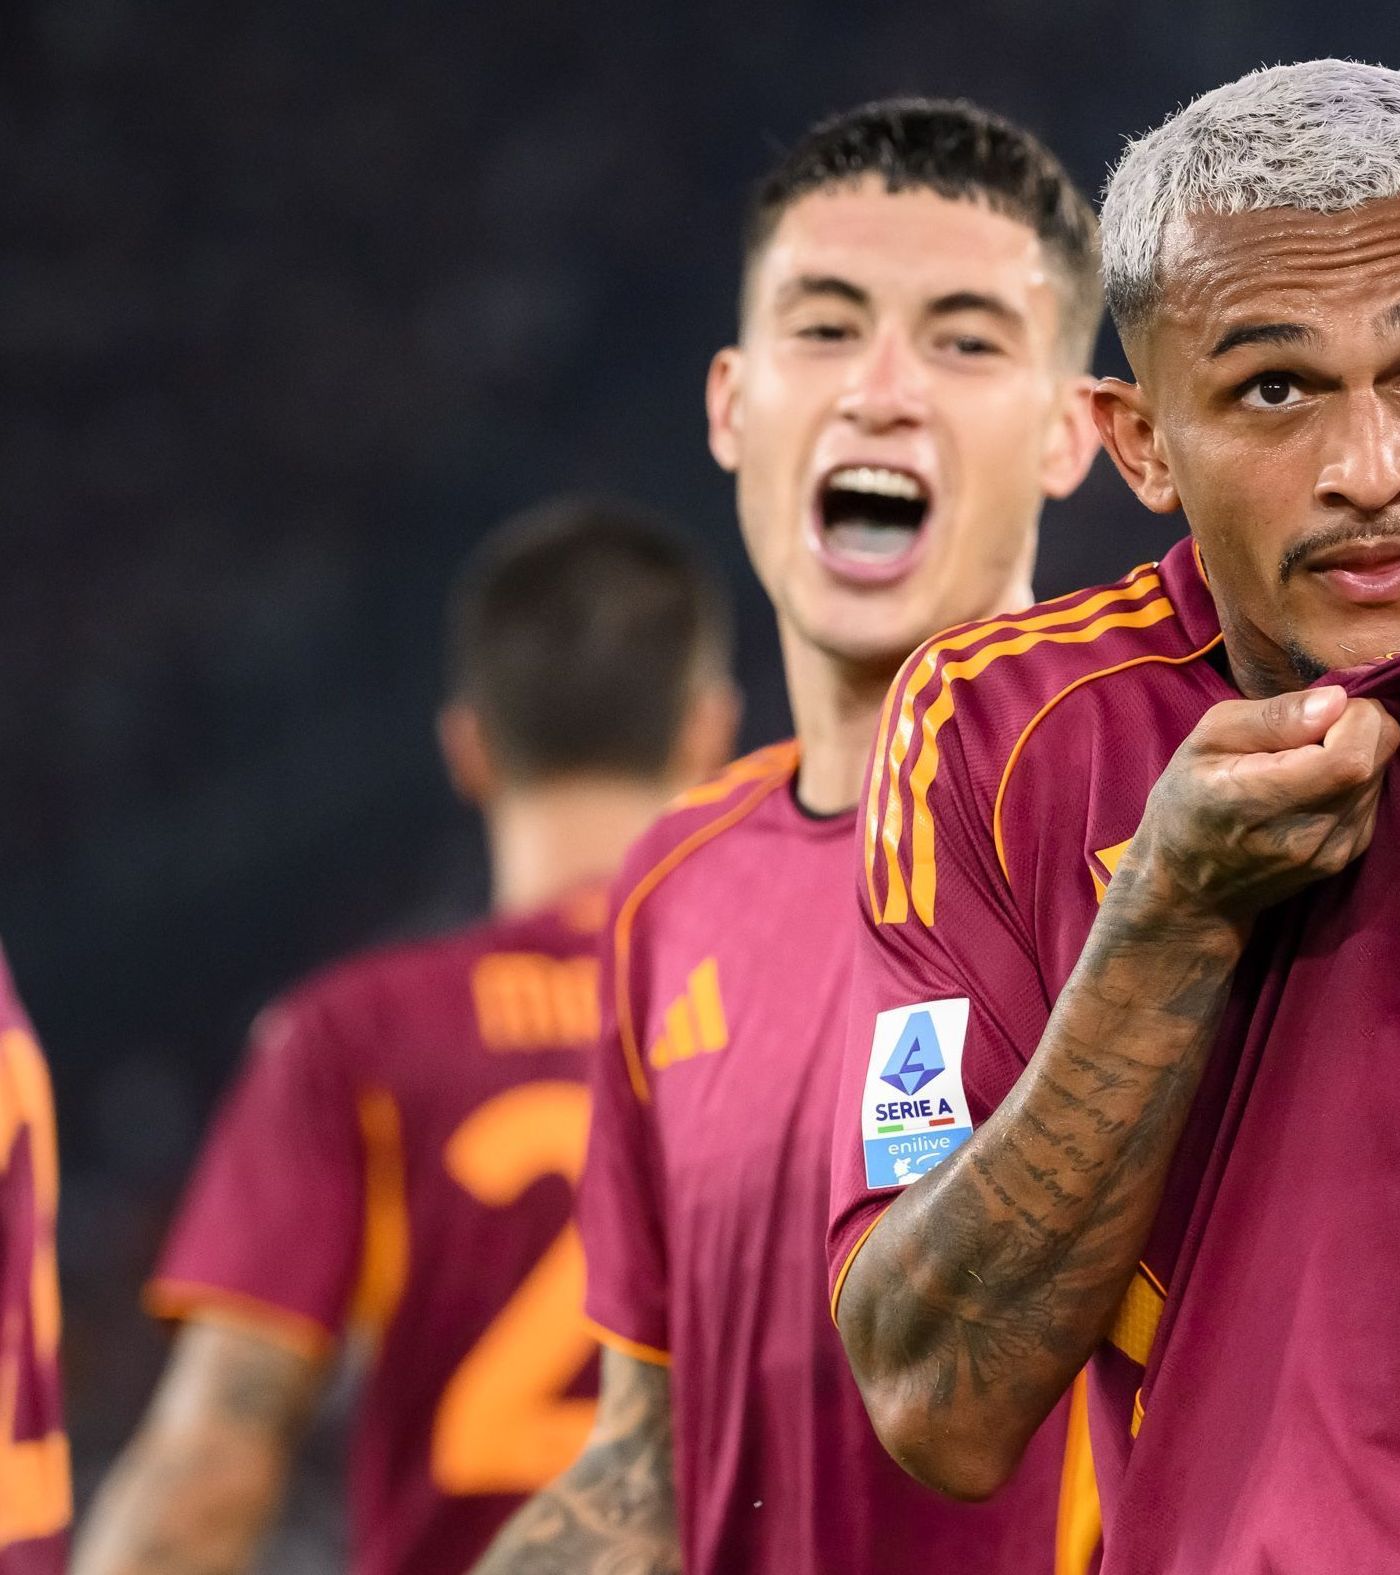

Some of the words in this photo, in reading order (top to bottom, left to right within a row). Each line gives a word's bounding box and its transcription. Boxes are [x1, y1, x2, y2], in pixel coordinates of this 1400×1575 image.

[875, 1099, 933, 1121] SERIE
[938, 1097, 954, 1115] A
[888, 1136, 951, 1155] enilive
